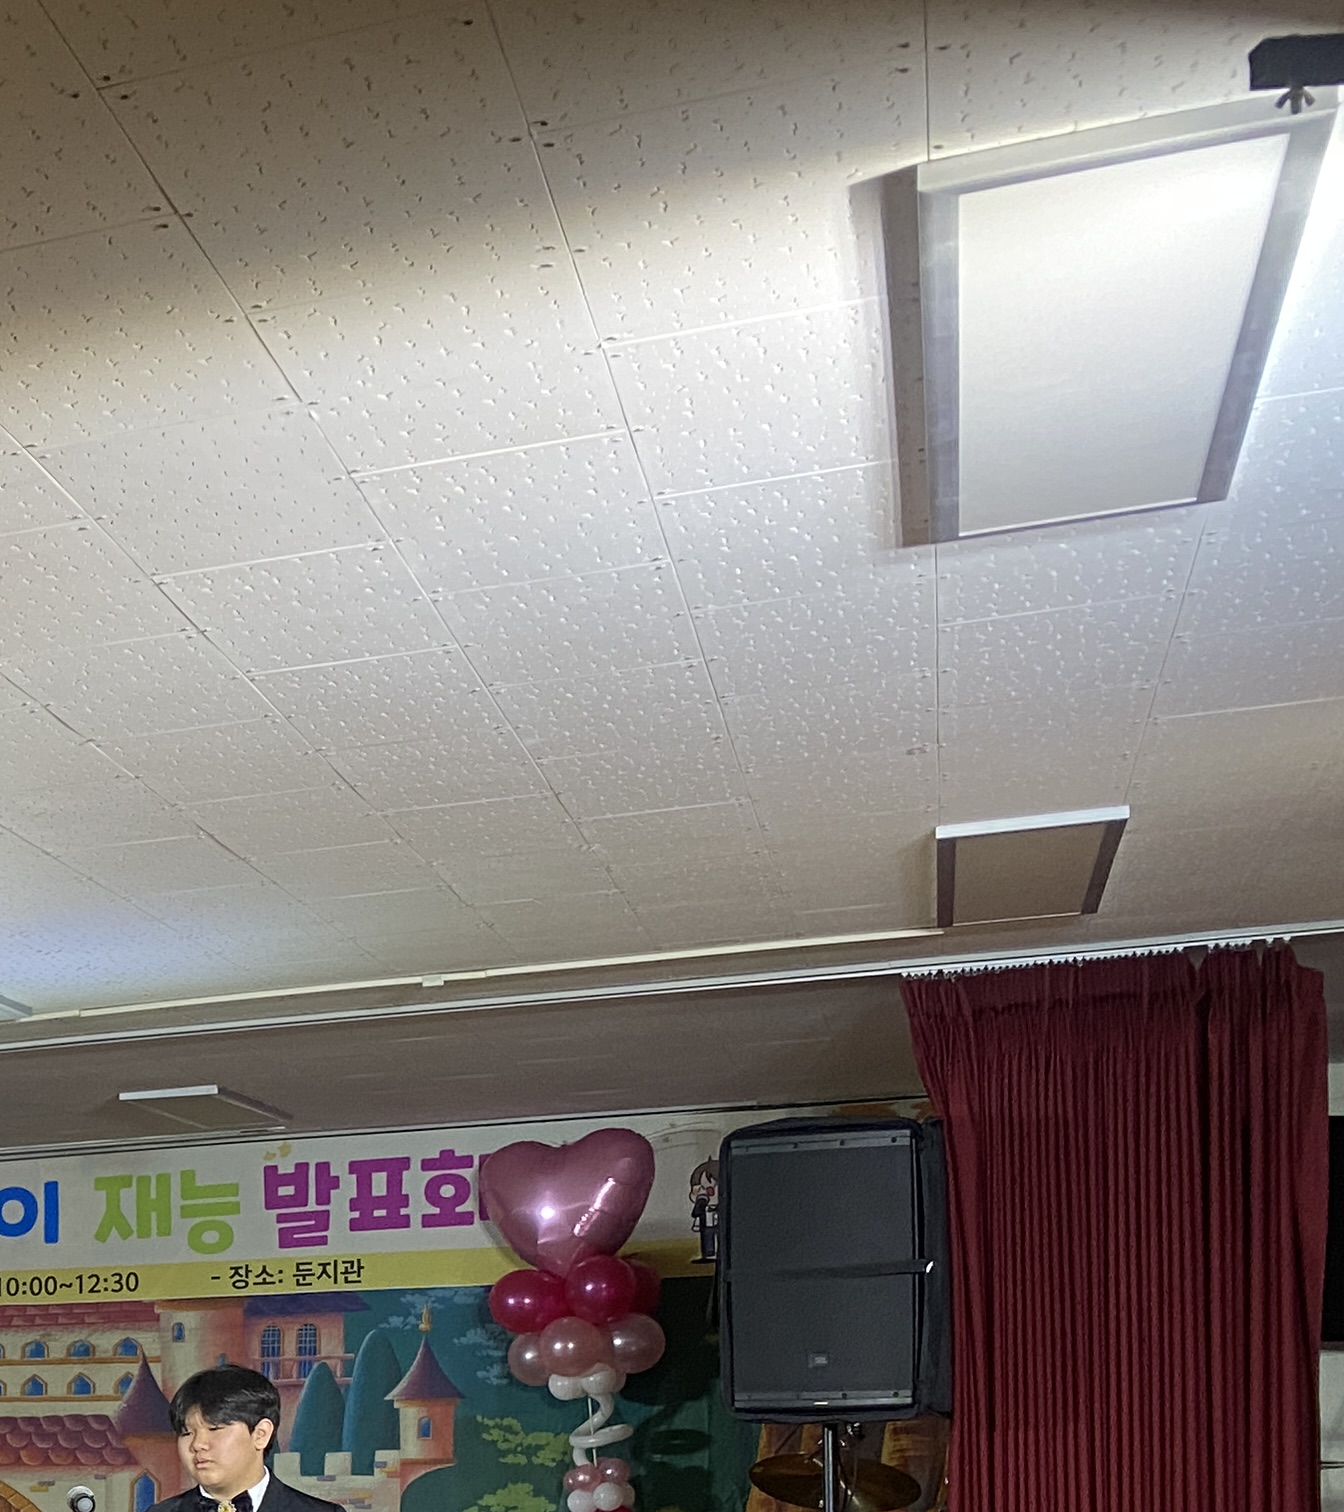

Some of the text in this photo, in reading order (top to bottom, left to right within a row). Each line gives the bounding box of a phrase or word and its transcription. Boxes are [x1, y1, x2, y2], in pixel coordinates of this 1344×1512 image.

[93, 1169, 241, 1255] 재능
[228, 1264, 284, 1290] 장소:
[292, 1257, 365, 1287] 둔지관
